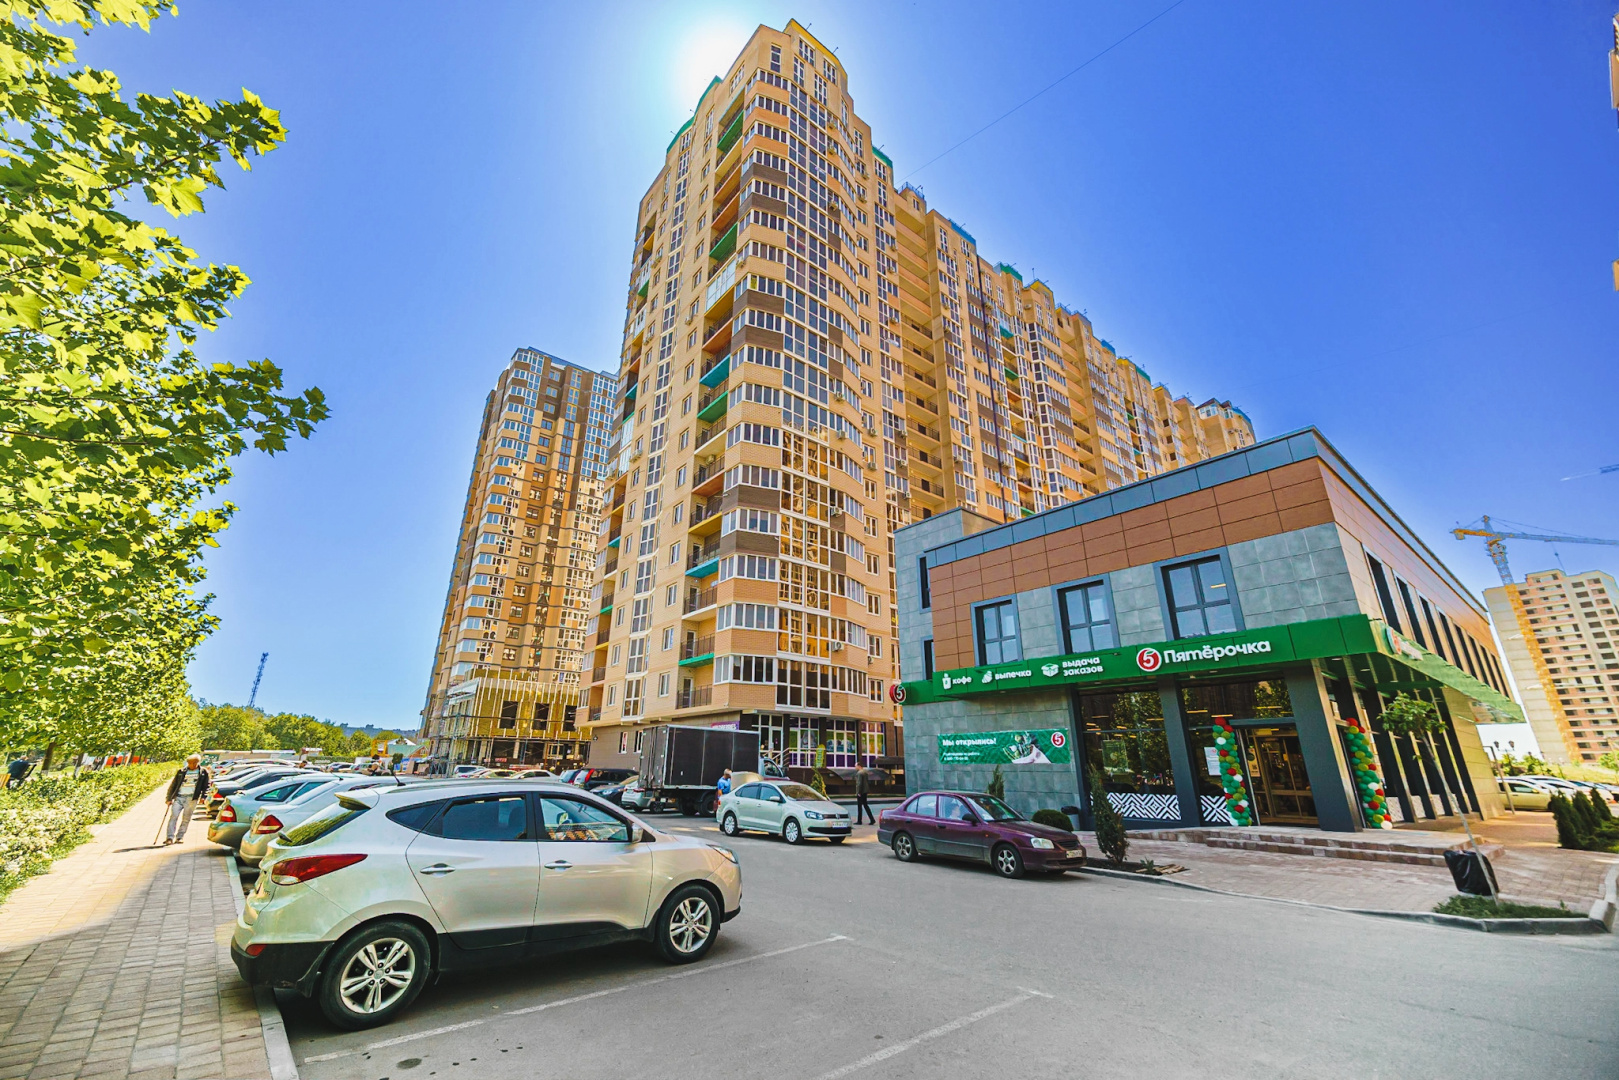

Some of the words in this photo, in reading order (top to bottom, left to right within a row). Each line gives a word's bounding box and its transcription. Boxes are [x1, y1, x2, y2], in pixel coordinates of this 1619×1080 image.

[1142, 650, 1156, 667] 5
[1163, 641, 1271, 663] Пятёрочка
[1062, 656, 1101, 669] выдача
[995, 670, 1031, 680] выпечка
[1063, 665, 1104, 677] заказов
[952, 676, 972, 685] кофе
